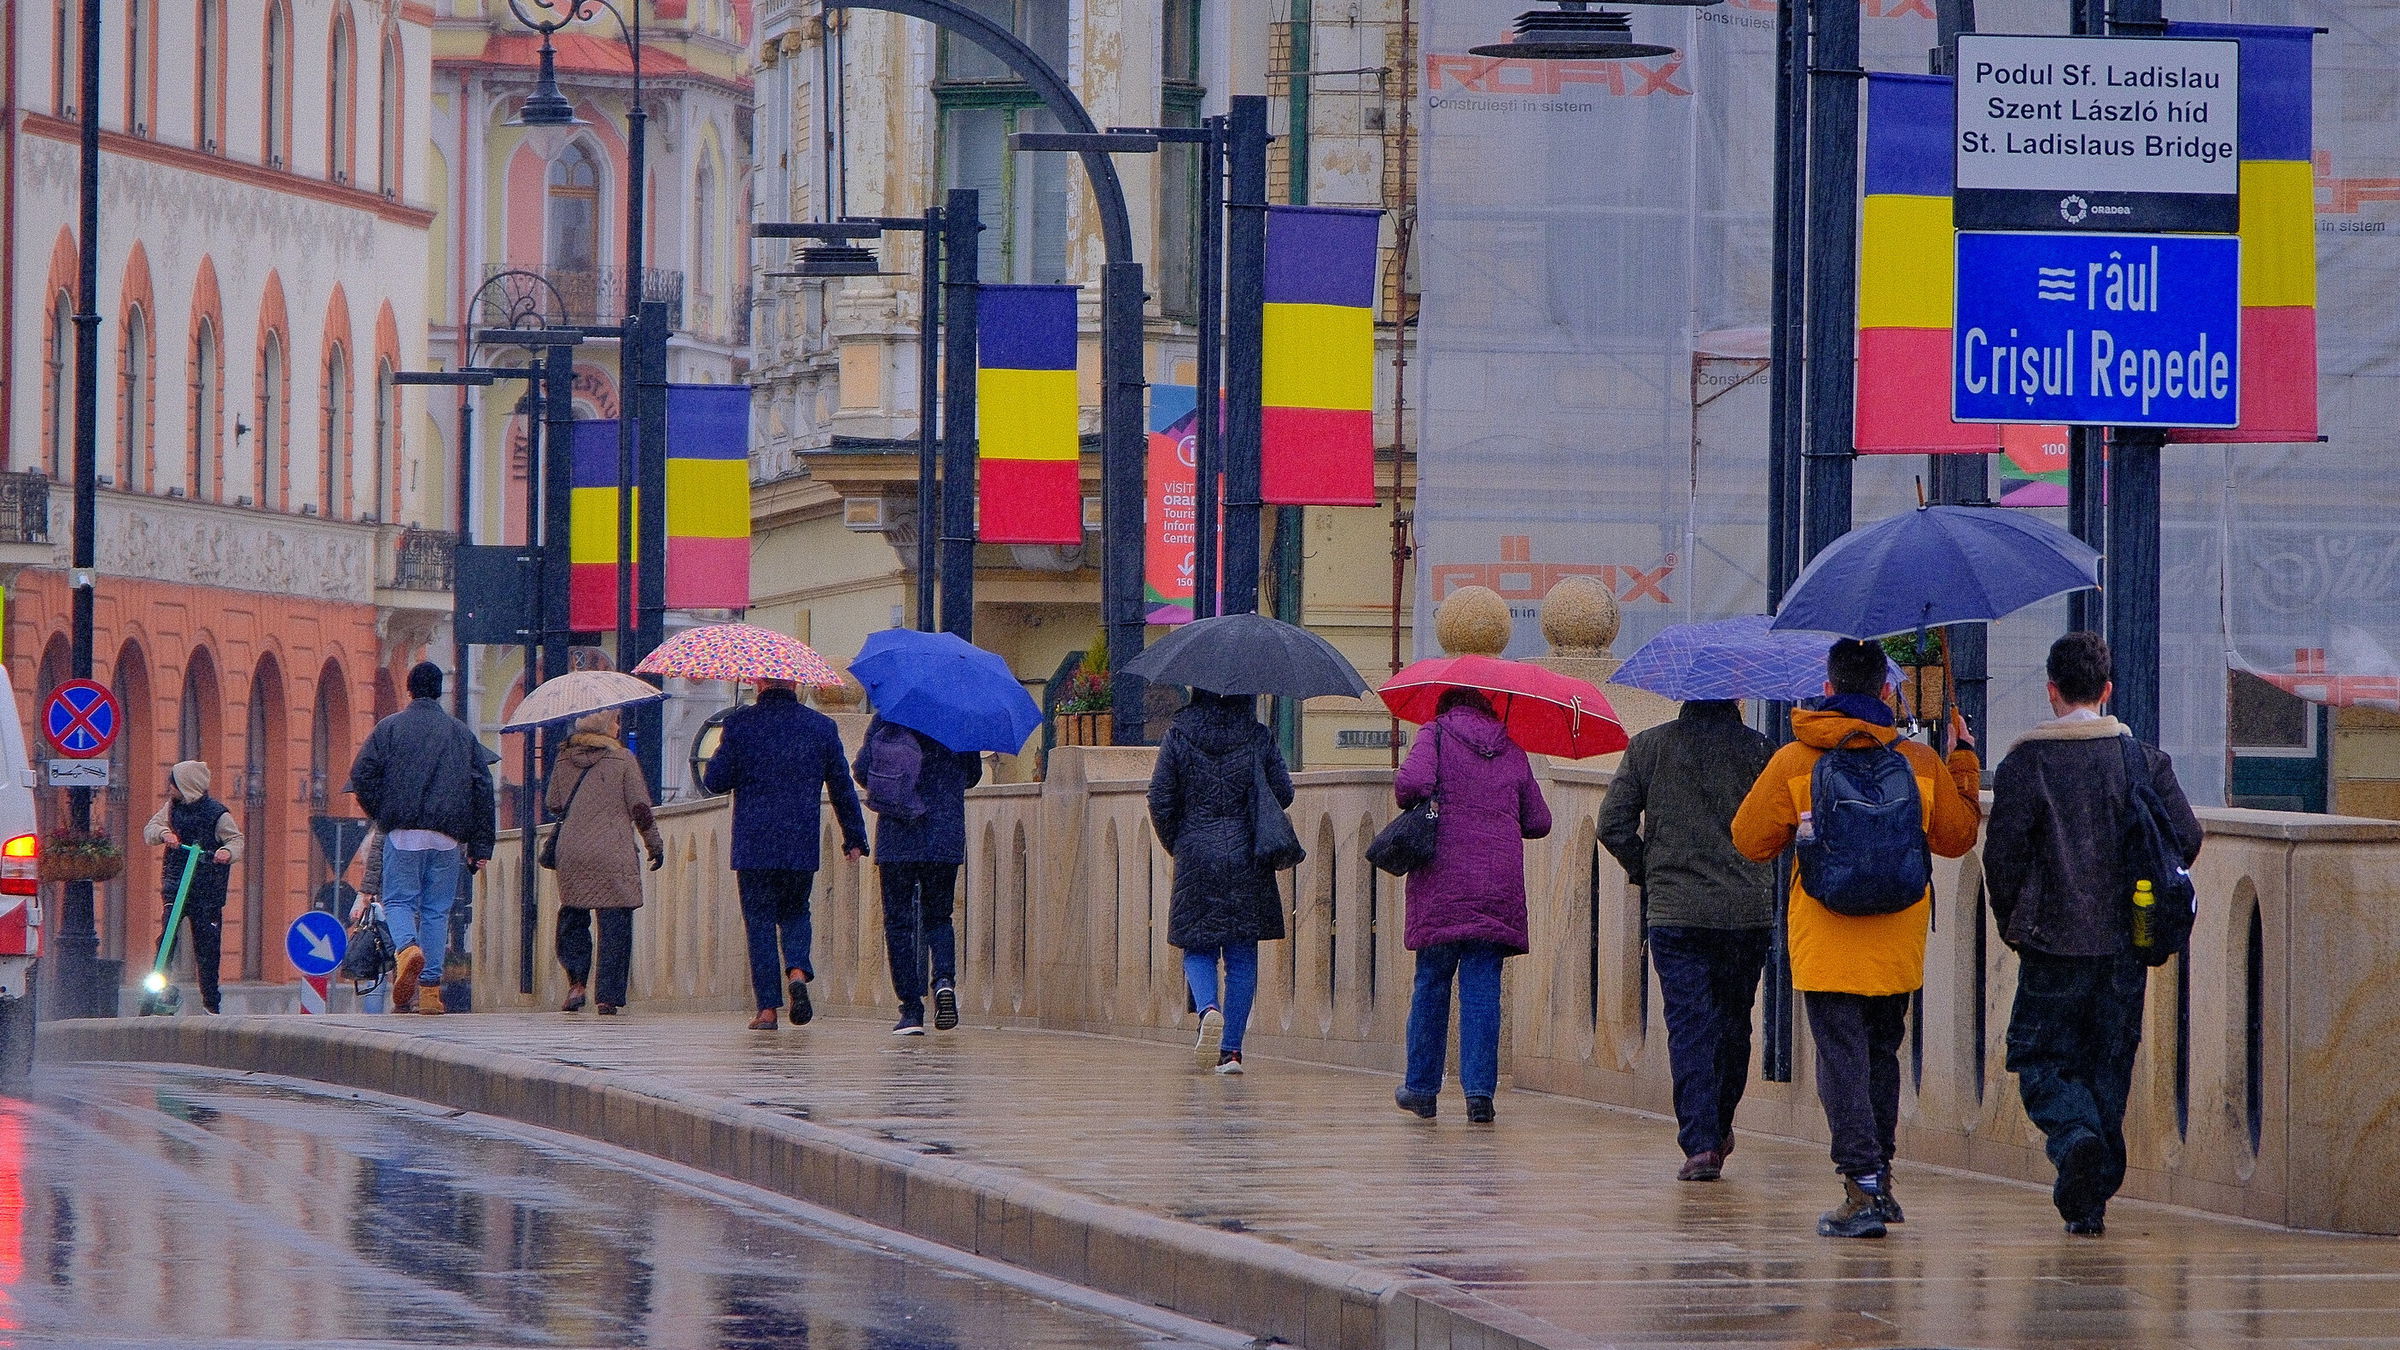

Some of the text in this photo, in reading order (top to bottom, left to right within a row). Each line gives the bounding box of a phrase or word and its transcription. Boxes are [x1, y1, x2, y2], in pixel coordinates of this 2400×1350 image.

[1976, 62, 2220, 89] Podul Sf. Ladislau
[1542, 101, 1593, 113] sistem
[1987, 97, 2208, 123] Szent László híd
[1962, 131, 2233, 164] St. Ladislaus Bridge
[2339, 219, 2386, 232] sistem
[2088, 245, 2158, 312] râul
[1964, 327, 2230, 416] Crișul Repede
[2042, 443, 2066, 455] 100
